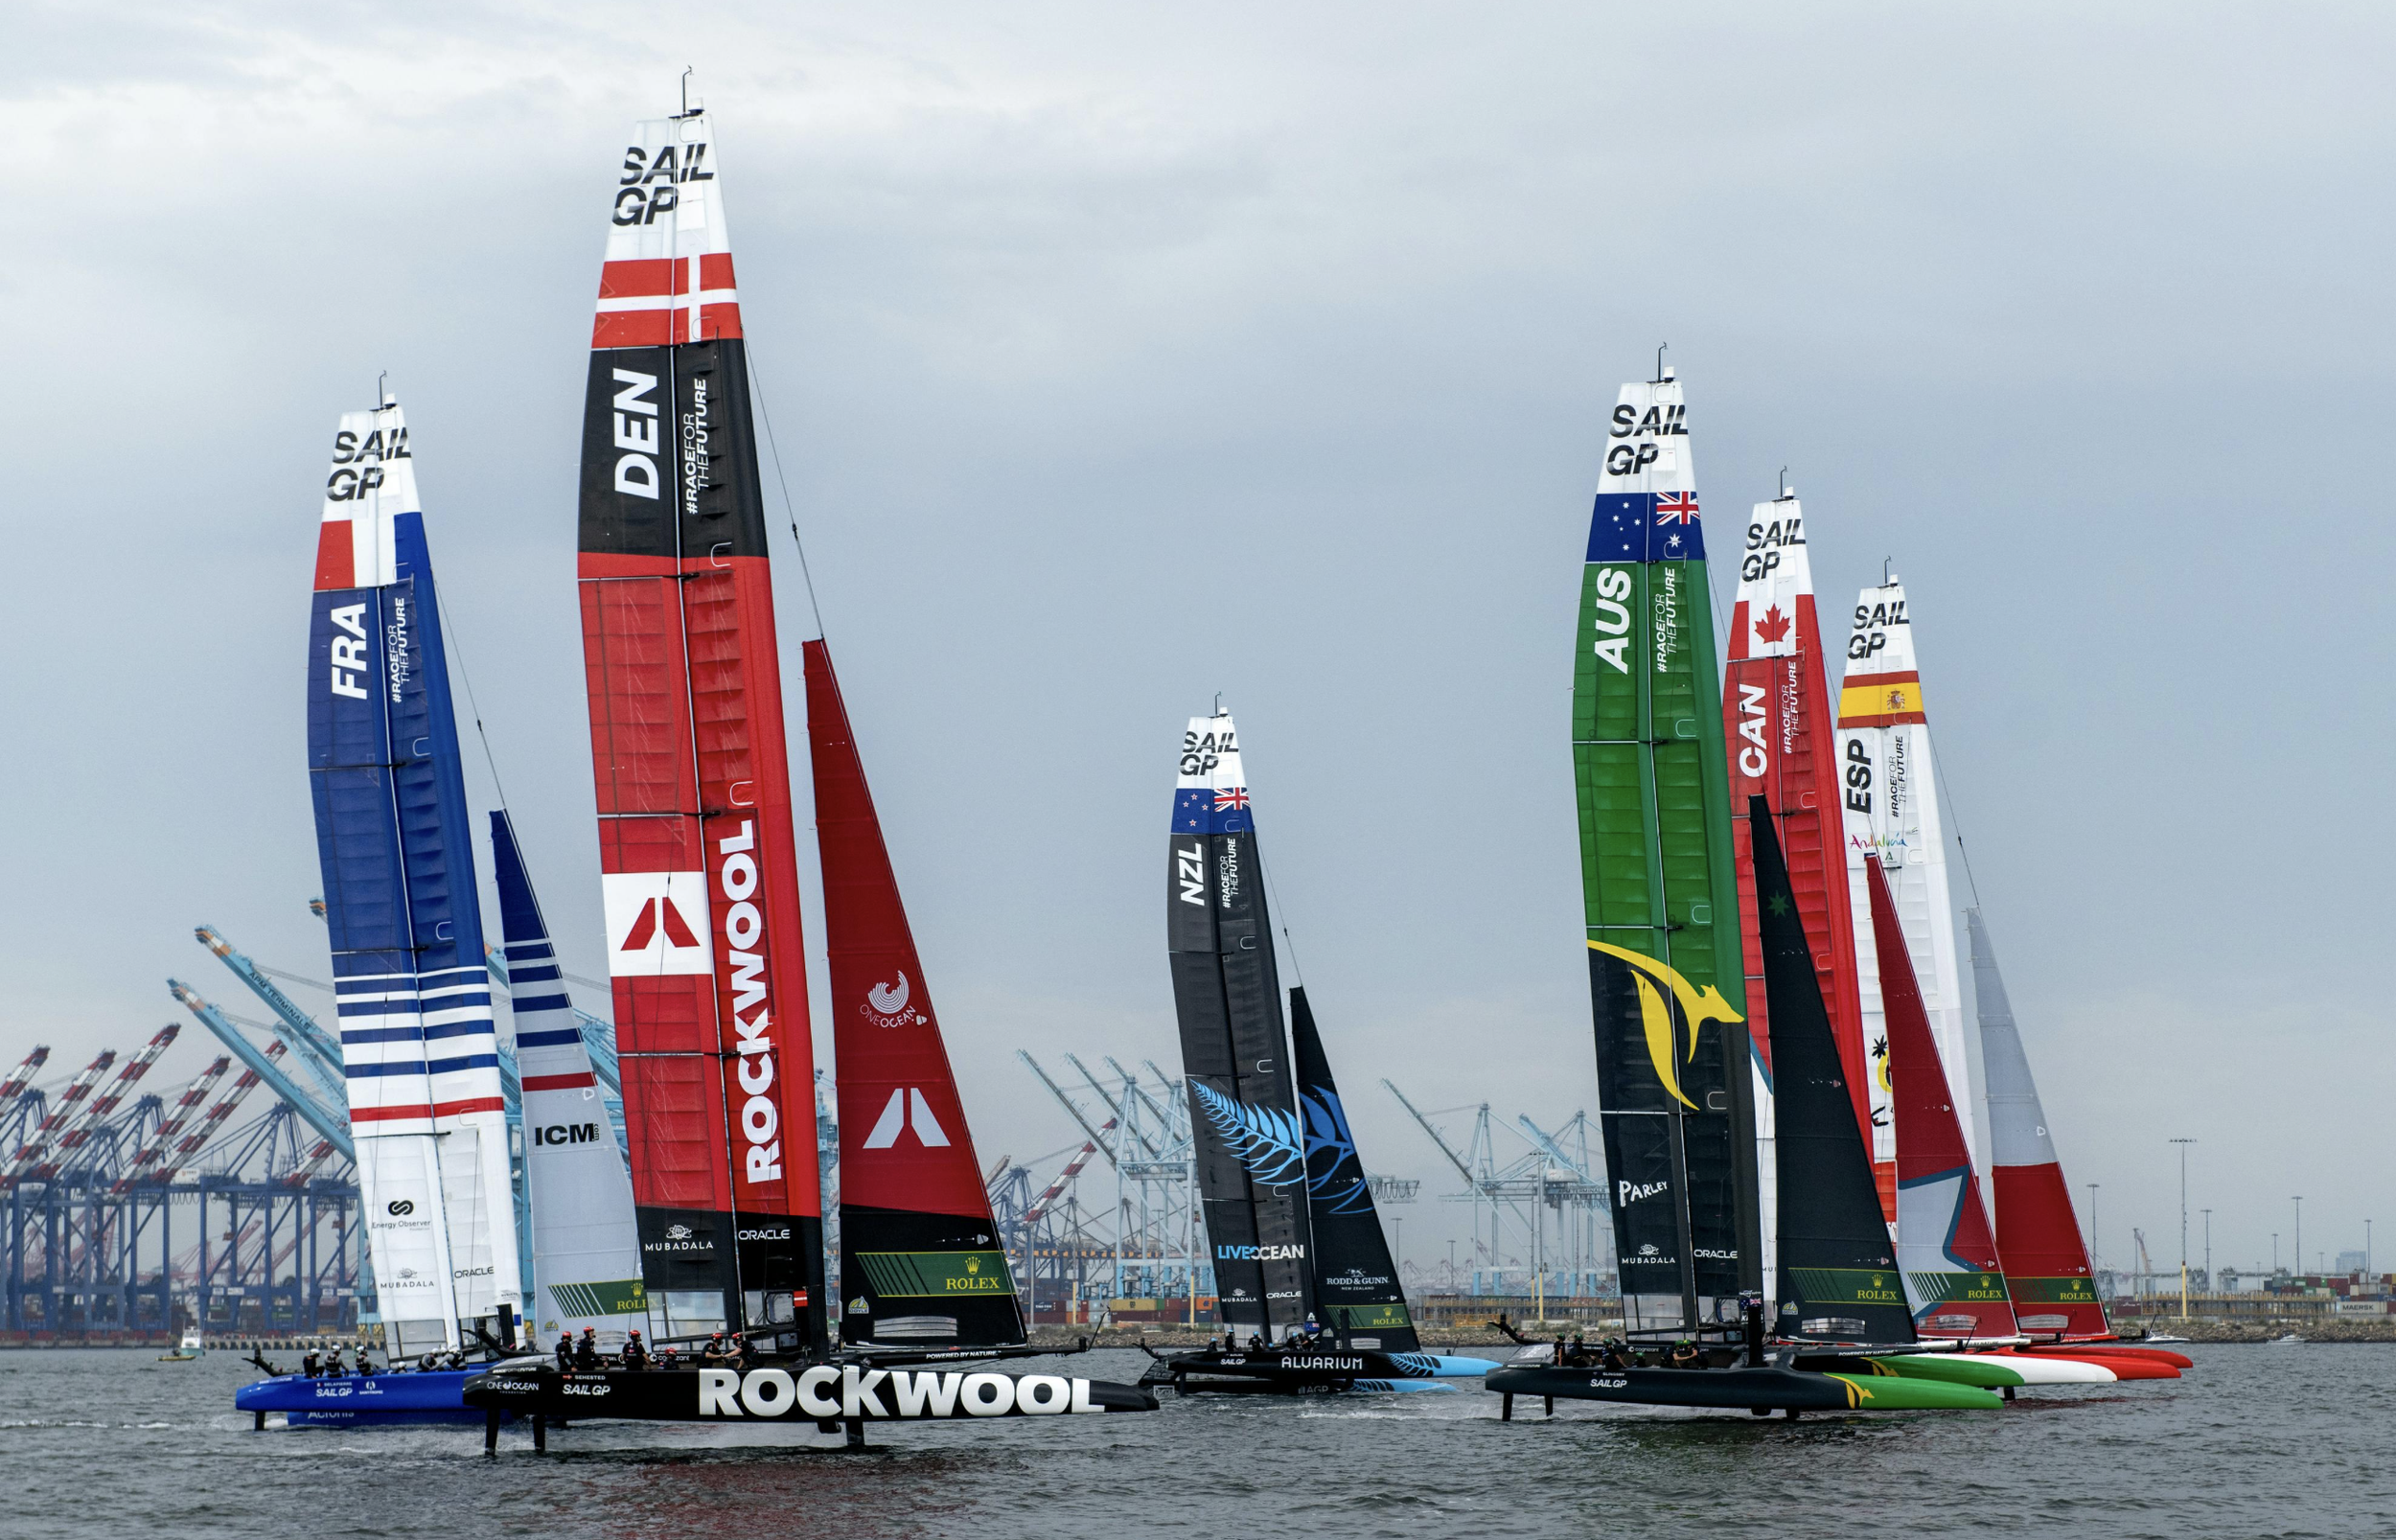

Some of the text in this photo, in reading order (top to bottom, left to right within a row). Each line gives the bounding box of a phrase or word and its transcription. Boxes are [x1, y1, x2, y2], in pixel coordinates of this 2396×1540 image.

[620, 143, 714, 185] SAIL
[611, 186, 680, 226] GP
[612, 367, 659, 500] DEN
[694, 378, 709, 491] THEFUTURE
[1609, 403, 1689, 438] SAIL
[332, 426, 412, 465] SAIL
[1605, 443, 1659, 476] GP
[683, 413, 698, 515] #RACEFOR
[326, 467, 385, 501] GP
[1745, 518, 1807, 551] SAIL
[1740, 551, 1781, 583] GP
[1594, 567, 1631, 676] AUS
[1664, 566, 1677, 655] THEFUTURE
[1853, 601, 1910, 631] SAIL
[397, 597, 411, 684] THEFUTURE
[1655, 592, 1667, 673] #RACEFOR
[1847, 632, 1887, 660] GP
[331, 603, 368, 700] FRA
[389, 624, 403, 703] #RACEFOR
[1788, 660, 1798, 738] THEFUTURE
[1739, 683, 1768, 778] CAN
[1782, 684, 1792, 755] #RACEFOR
[1182, 730, 1239, 753] SAIL
[1179, 753, 1219, 776] GP
[1846, 738, 1872, 815] ESP
[1895, 735, 1904, 804] THEFUTURE
[1889, 755, 1899, 817] #RACEFOR
[1178, 842, 1205, 907] NZL
[1220, 855, 1231, 908] #RACEFOR
[1227, 838, 1239, 896] THEFUTURE
[248, 972, 311, 1030] APM TERMINALS
[720, 819, 782, 1184] ROCKWOOL
[535, 1122, 594, 1146] ICM
[1619, 1180, 1668, 1207] PARLEY
[372, 1219, 431, 1230] Energy Observer
[738, 1229, 791, 1241] ORACLE
[645, 1240, 714, 1252] MUBADALA
[1693, 1249, 1738, 1259] ORACLE
[380, 1280, 434, 1289] MUBADALA
[453, 1266, 495, 1279] ORACLE
[945, 1276, 1000, 1290] ROLEX
[1361, 1276, 1389, 1285] GUNN
[1266, 1291, 1302, 1299] ORACLE
[1857, 1290, 1898, 1300] ROLEX
[1968, 1289, 2003, 1299] ROLEX
[2060, 1292, 2093, 1301] ROLEX
[1281, 1356, 1363, 1370] ALVARIUM
[315, 1388, 353, 1397] SAIL GP
[487, 1381, 539, 1391] ONE OCEAN
[563, 1384, 611, 1395] SAIL GP
[699, 1365, 1105, 1417] ROCKWOOL
[1306, 1385, 1328, 1394] AGP
[1590, 1379, 1612, 1388] SAIL
